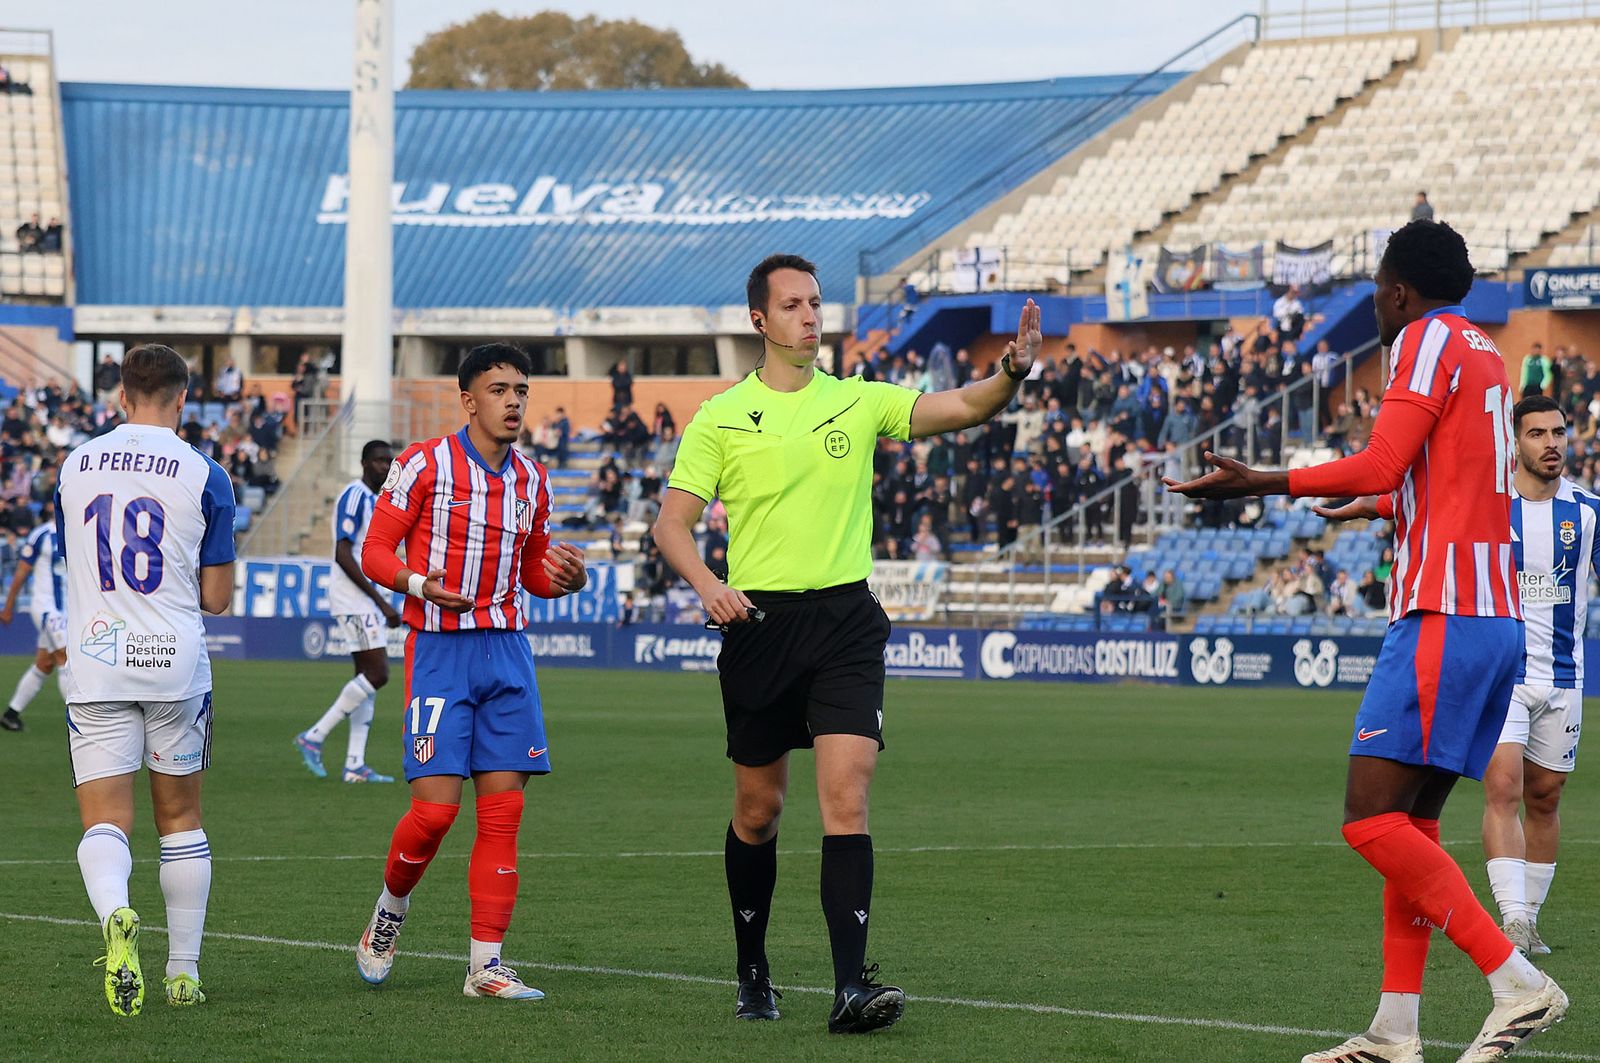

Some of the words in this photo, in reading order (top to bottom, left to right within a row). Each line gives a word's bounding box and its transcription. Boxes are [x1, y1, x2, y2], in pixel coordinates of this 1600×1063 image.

[79, 454, 93, 473] D.
[98, 452, 180, 478] PEREJON
[84, 493, 165, 596] 18
[1517, 572, 1545, 586] lter
[1519, 586, 1570, 598] nersun
[126, 631, 177, 645] Agencia
[126, 644, 176, 656] Destino
[884, 632, 964, 667] xaBank
[1013, 643, 1095, 675] COPIADORAS
[1095, 639, 1179, 677] COSTALUZ
[126, 656, 171, 668] Huelva
[410, 696, 446, 735] 17
